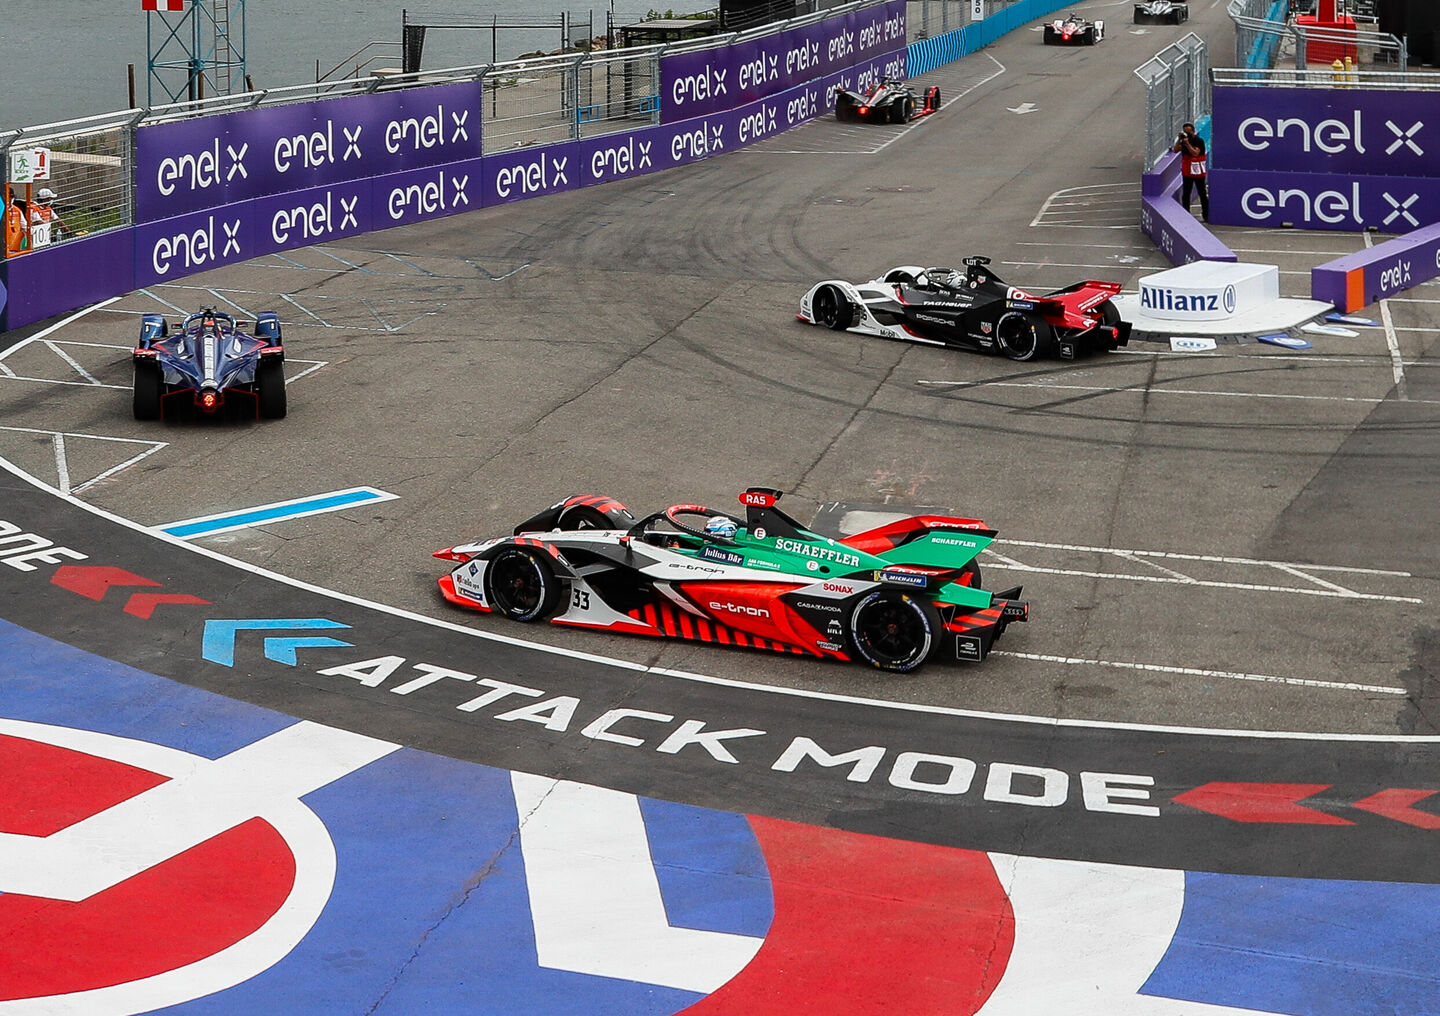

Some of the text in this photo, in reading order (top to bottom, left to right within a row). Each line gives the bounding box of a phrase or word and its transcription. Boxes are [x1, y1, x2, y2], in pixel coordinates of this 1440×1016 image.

[828, 28, 854, 62] enel x
[859, 20, 882, 51] enel x
[884, 12, 905, 42] enel x
[739, 51, 779, 90] enel x
[786, 38, 819, 75] enel x
[673, 65, 727, 105] enel x
[739, 103, 777, 143] enel x
[787, 88, 818, 124] enel x
[274, 119, 363, 173] enel x
[384, 104, 469, 154] enel x
[671, 121, 724, 161] enel x
[1237, 109, 1425, 157] enel x
[157, 138, 249, 196] enel x
[496, 152, 568, 198] enel x
[591, 136, 652, 179] enel x
[387, 170, 470, 220] enel x
[1241, 181, 1420, 228] enel x
[271, 191, 358, 245] enel x
[152, 215, 242, 275] enel x
[1380, 259, 1412, 292] enel x
[1141, 286, 1219, 312] Allianz
[745, 493, 766, 505] RAS
[703, 547, 727, 561] Julius
[775, 538, 860, 568] SCHAEFFLER
[931, 537, 977, 548] SCHAEFFLER
[668, 562, 725, 575] e-tron
[888, 575, 923, 584] MICHELIN
[572, 587, 590, 611] 33
[823, 583, 854, 594] SONAX
[709, 601, 771, 619] e-tron
[317, 655, 1161, 818] ATTACK MODE
